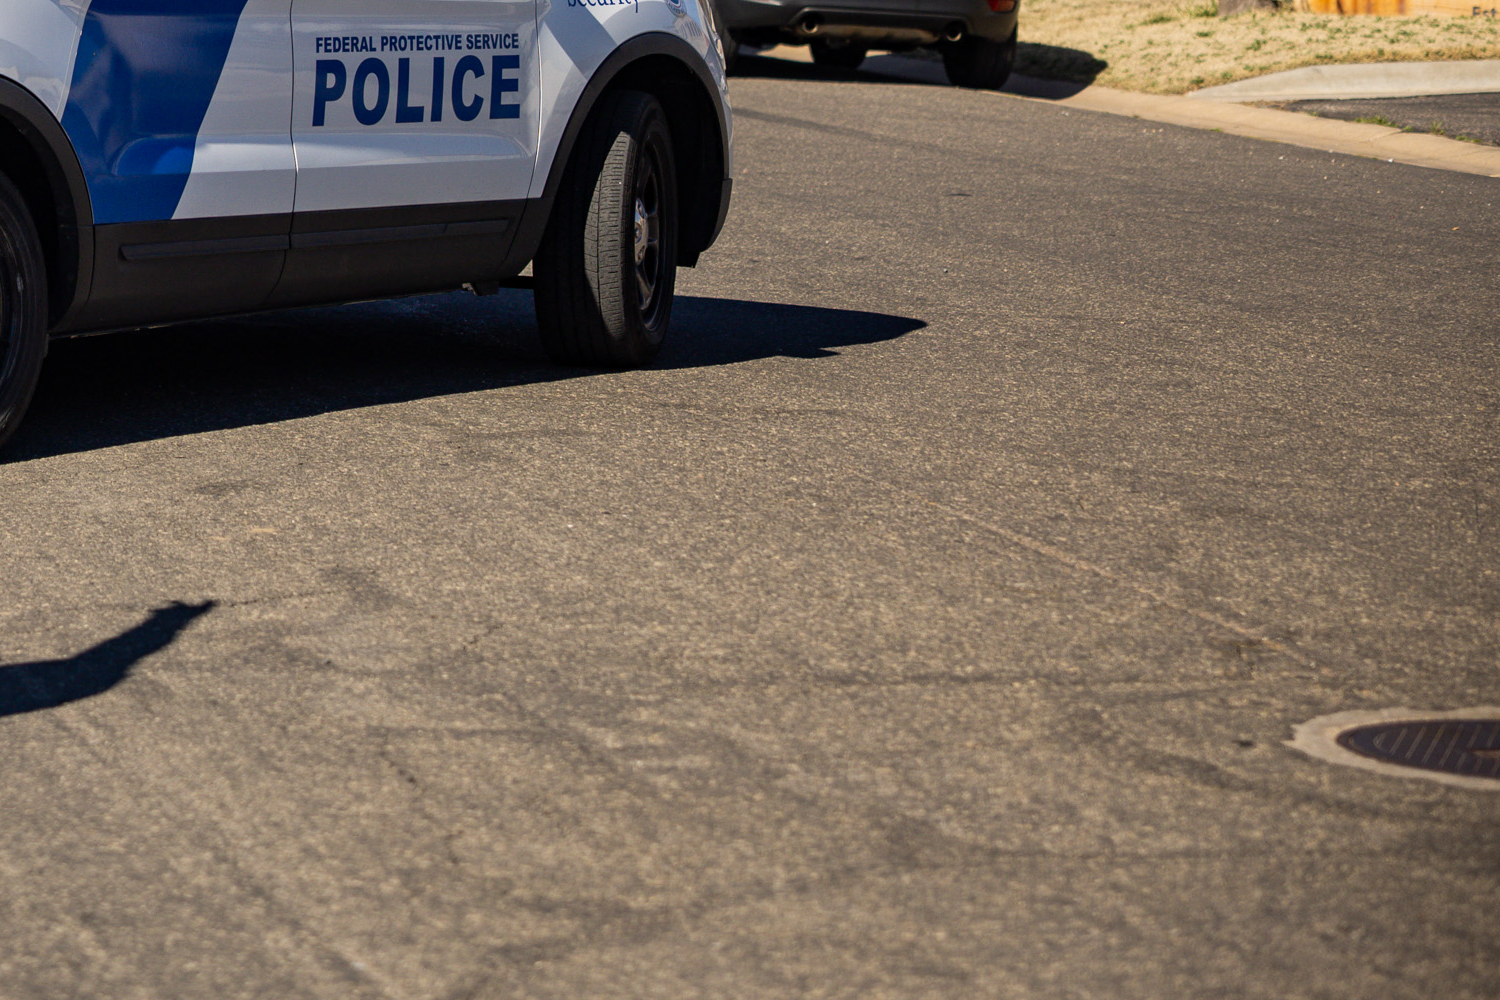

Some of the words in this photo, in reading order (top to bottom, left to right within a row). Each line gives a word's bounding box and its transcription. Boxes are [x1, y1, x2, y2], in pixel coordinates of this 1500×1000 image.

[315, 36, 377, 53] FEDERAL
[381, 34, 462, 52] PROTECTIVE
[466, 33, 519, 50] SERVICE
[312, 54, 520, 127] POLICE
